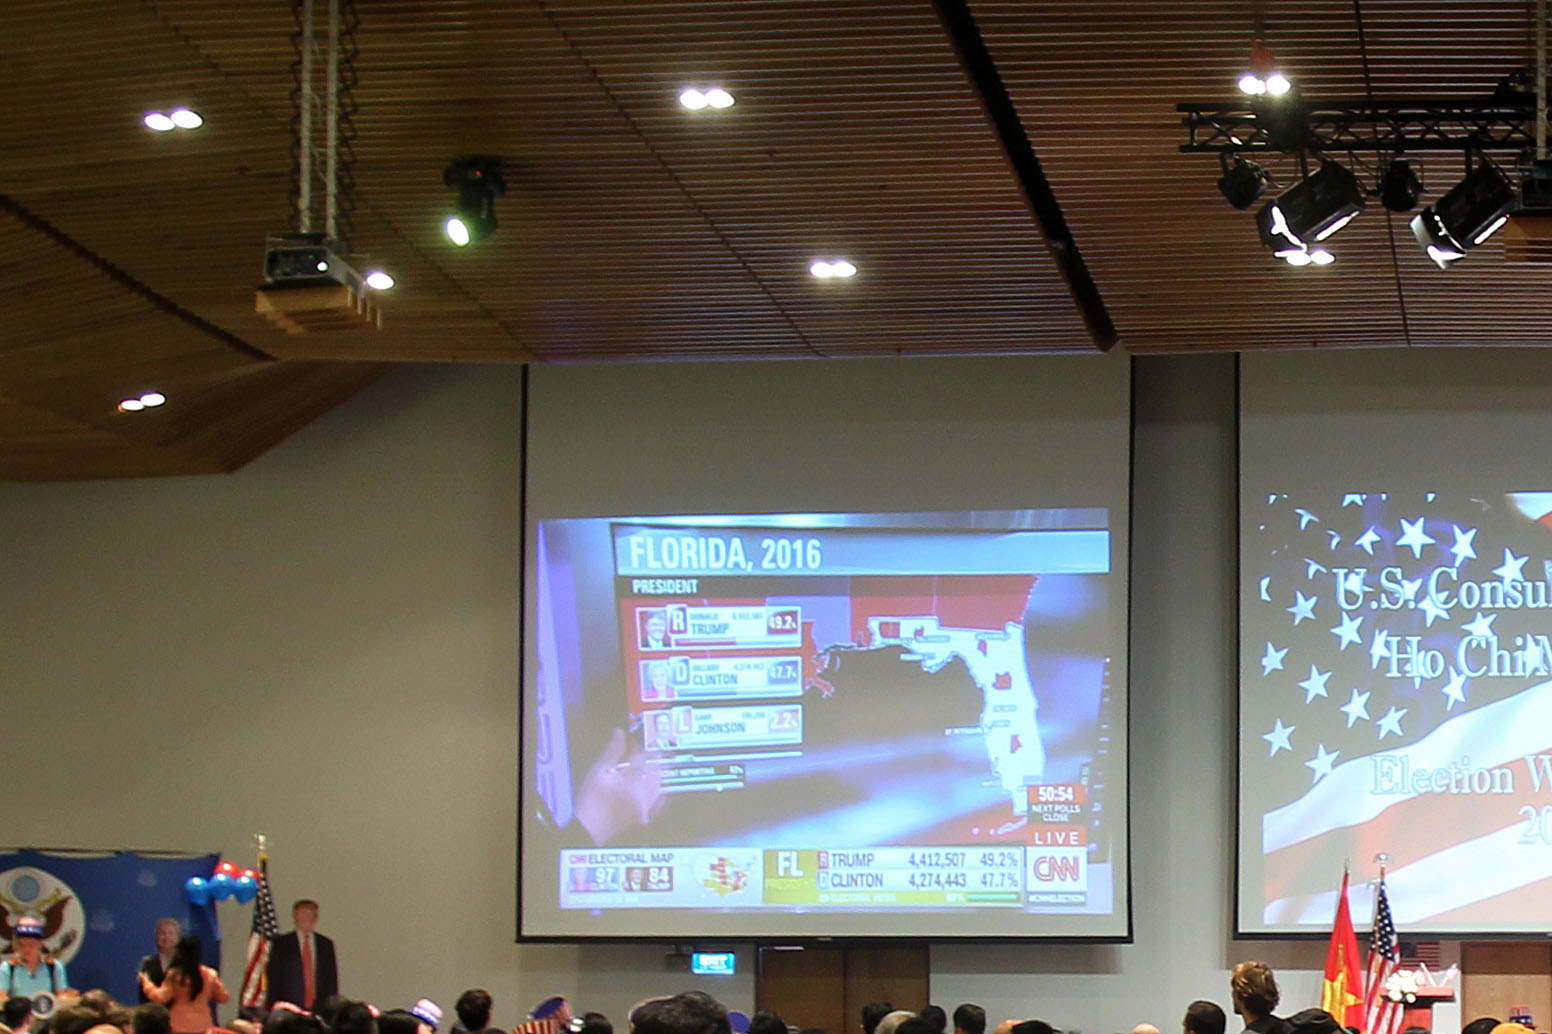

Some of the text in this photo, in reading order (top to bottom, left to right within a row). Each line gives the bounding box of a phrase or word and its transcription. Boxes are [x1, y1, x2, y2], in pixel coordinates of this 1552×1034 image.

[630, 536, 821, 572] FLORIDA, 2016
[632, 579, 699, 594] PRESIDENT
[1332, 568, 1417, 609] U.S.
[672, 609, 685, 631] R
[691, 623, 729, 635] TRUMP
[1385, 635, 1444, 677] Ho
[1456, 635, 1525, 677] Chi
[676, 665, 688, 683] D
[692, 673, 738, 686] CLINTON
[695, 722, 745, 735] JOHNSON
[1370, 752, 1514, 795] Election
[1038, 786, 1074, 802] 50:54
[1032, 804, 1080, 813] NEXT POLLS
[1043, 813, 1069, 822] CLOSE
[1034, 831, 1080, 845] LIVE
[588, 854, 648, 864] ELECTORAL
[651, 853, 675, 864] MAP
[777, 851, 805, 877] FL
[831, 852, 875, 867] TRUMP
[908, 852, 966, 869] 4,412,507
[980, 852, 1018, 867] 49.2%
[595, 868, 615, 885] 97
[650, 867, 670, 882] 84
[1033, 855, 1080, 882] CNN
[831, 872, 884, 888] CLINTON
[908, 872, 967, 890] 4,274,443
[980, 872, 1018, 887] 47.7%
